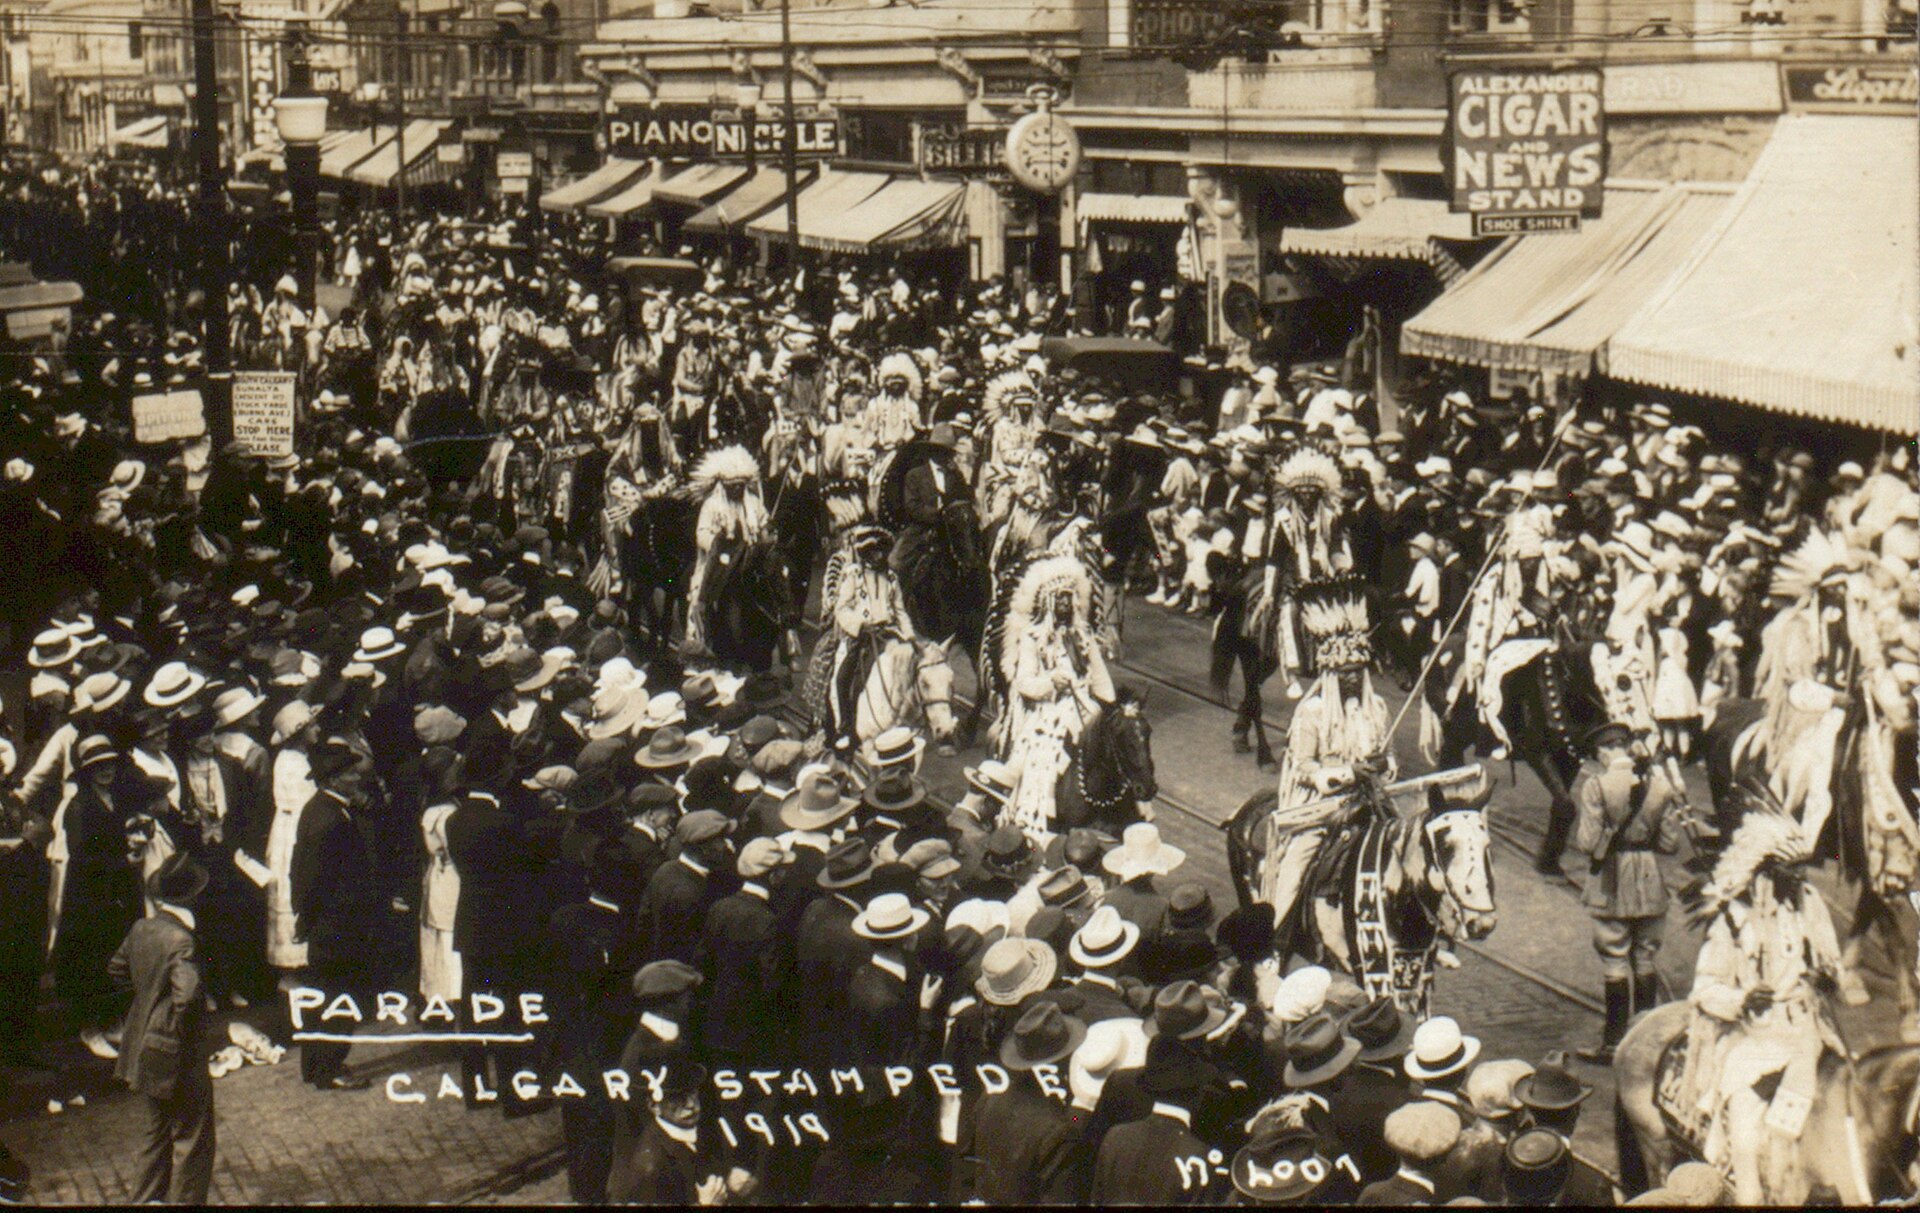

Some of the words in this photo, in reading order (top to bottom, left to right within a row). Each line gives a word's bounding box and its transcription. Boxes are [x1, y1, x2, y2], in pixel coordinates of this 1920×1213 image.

[1458, 73, 1599, 94] ALEXANDER
[1457, 92, 1601, 138] CIGAR
[610, 120, 713, 145] PIANO
[1508, 140, 1550, 153] AND
[1455, 142, 1601, 189] NEWS
[1467, 188, 1585, 211] STAND
[1483, 219, 1521, 232] SHOE
[1526, 217, 1573, 230] SHINE
[236, 425, 260, 434] STOP
[266, 426, 291, 435] HERE
